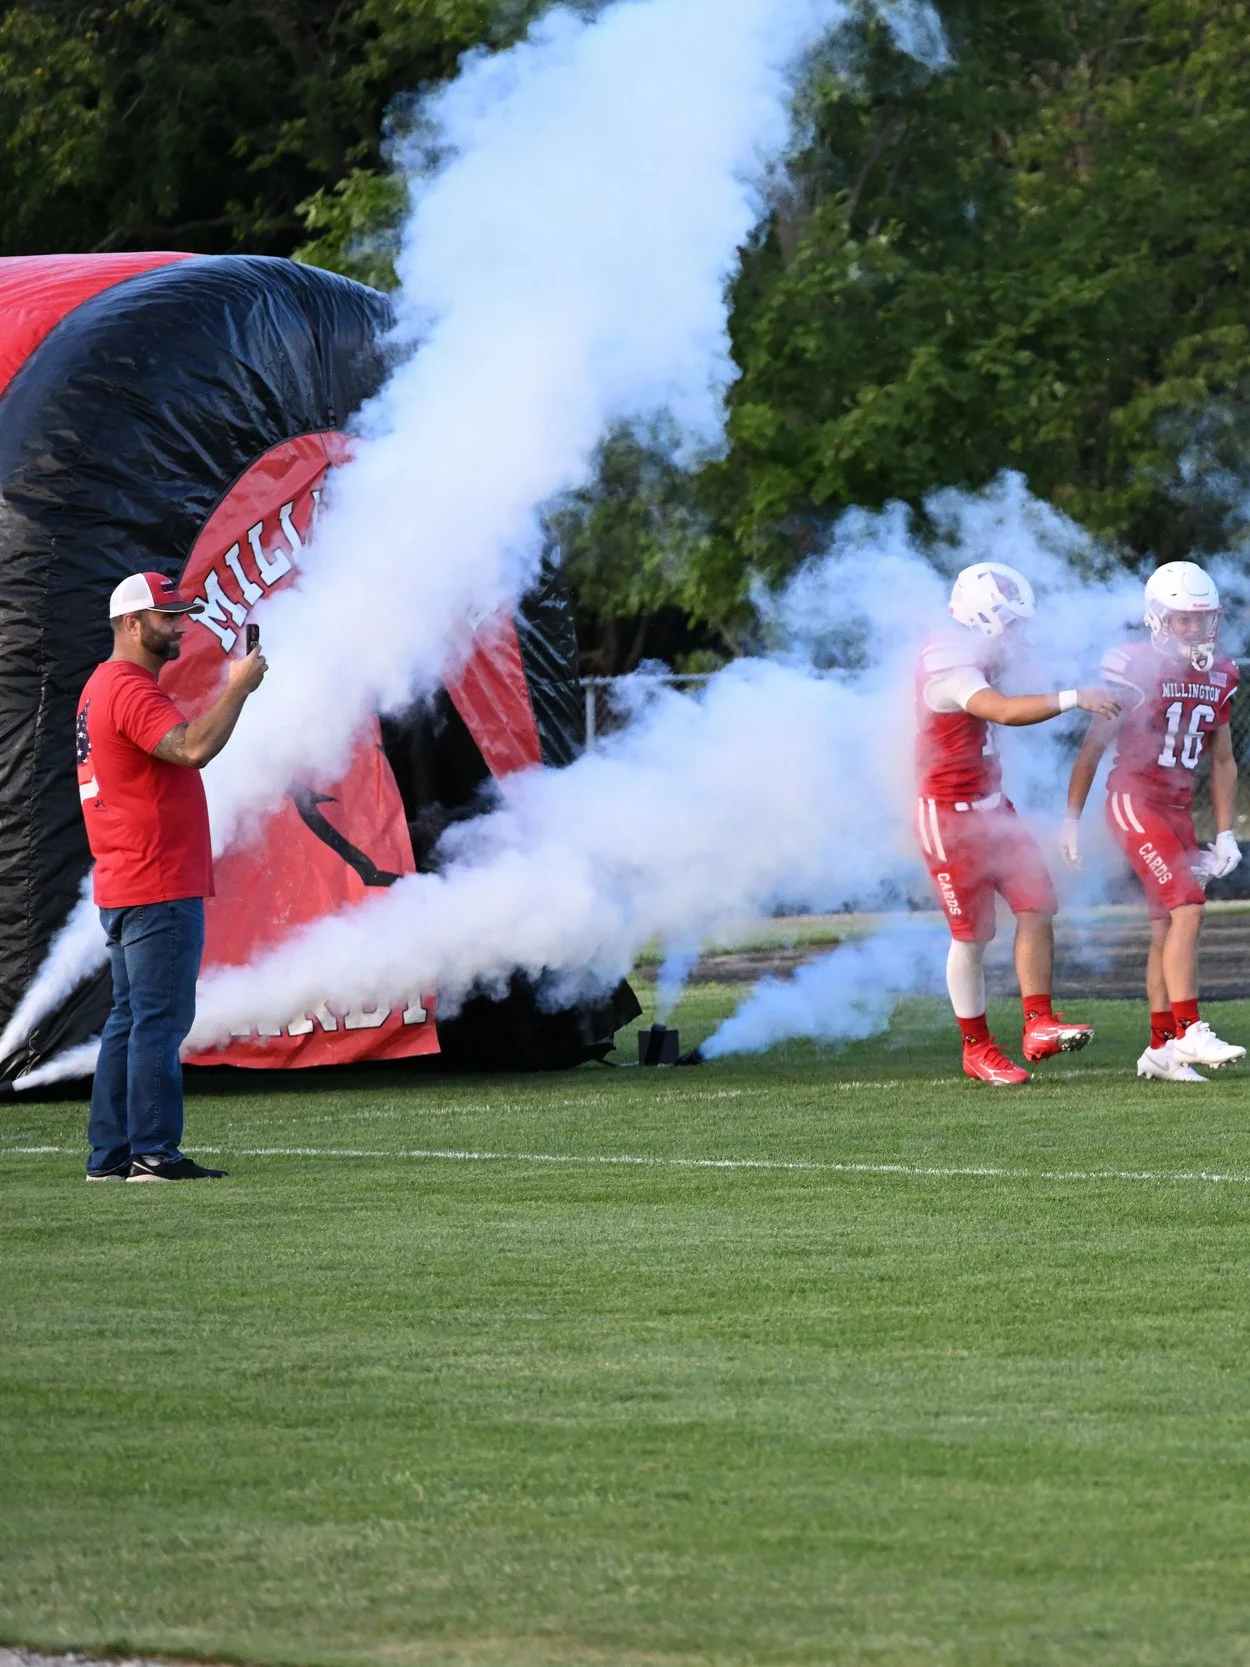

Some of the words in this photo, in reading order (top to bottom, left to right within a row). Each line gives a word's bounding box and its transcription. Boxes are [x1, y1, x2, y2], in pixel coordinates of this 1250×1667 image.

[1162, 683, 1222, 703] MILLINGTON
[1157, 702, 1216, 770] 16
[1138, 842, 1173, 885] CARDS
[937, 872, 962, 915] CARDS
